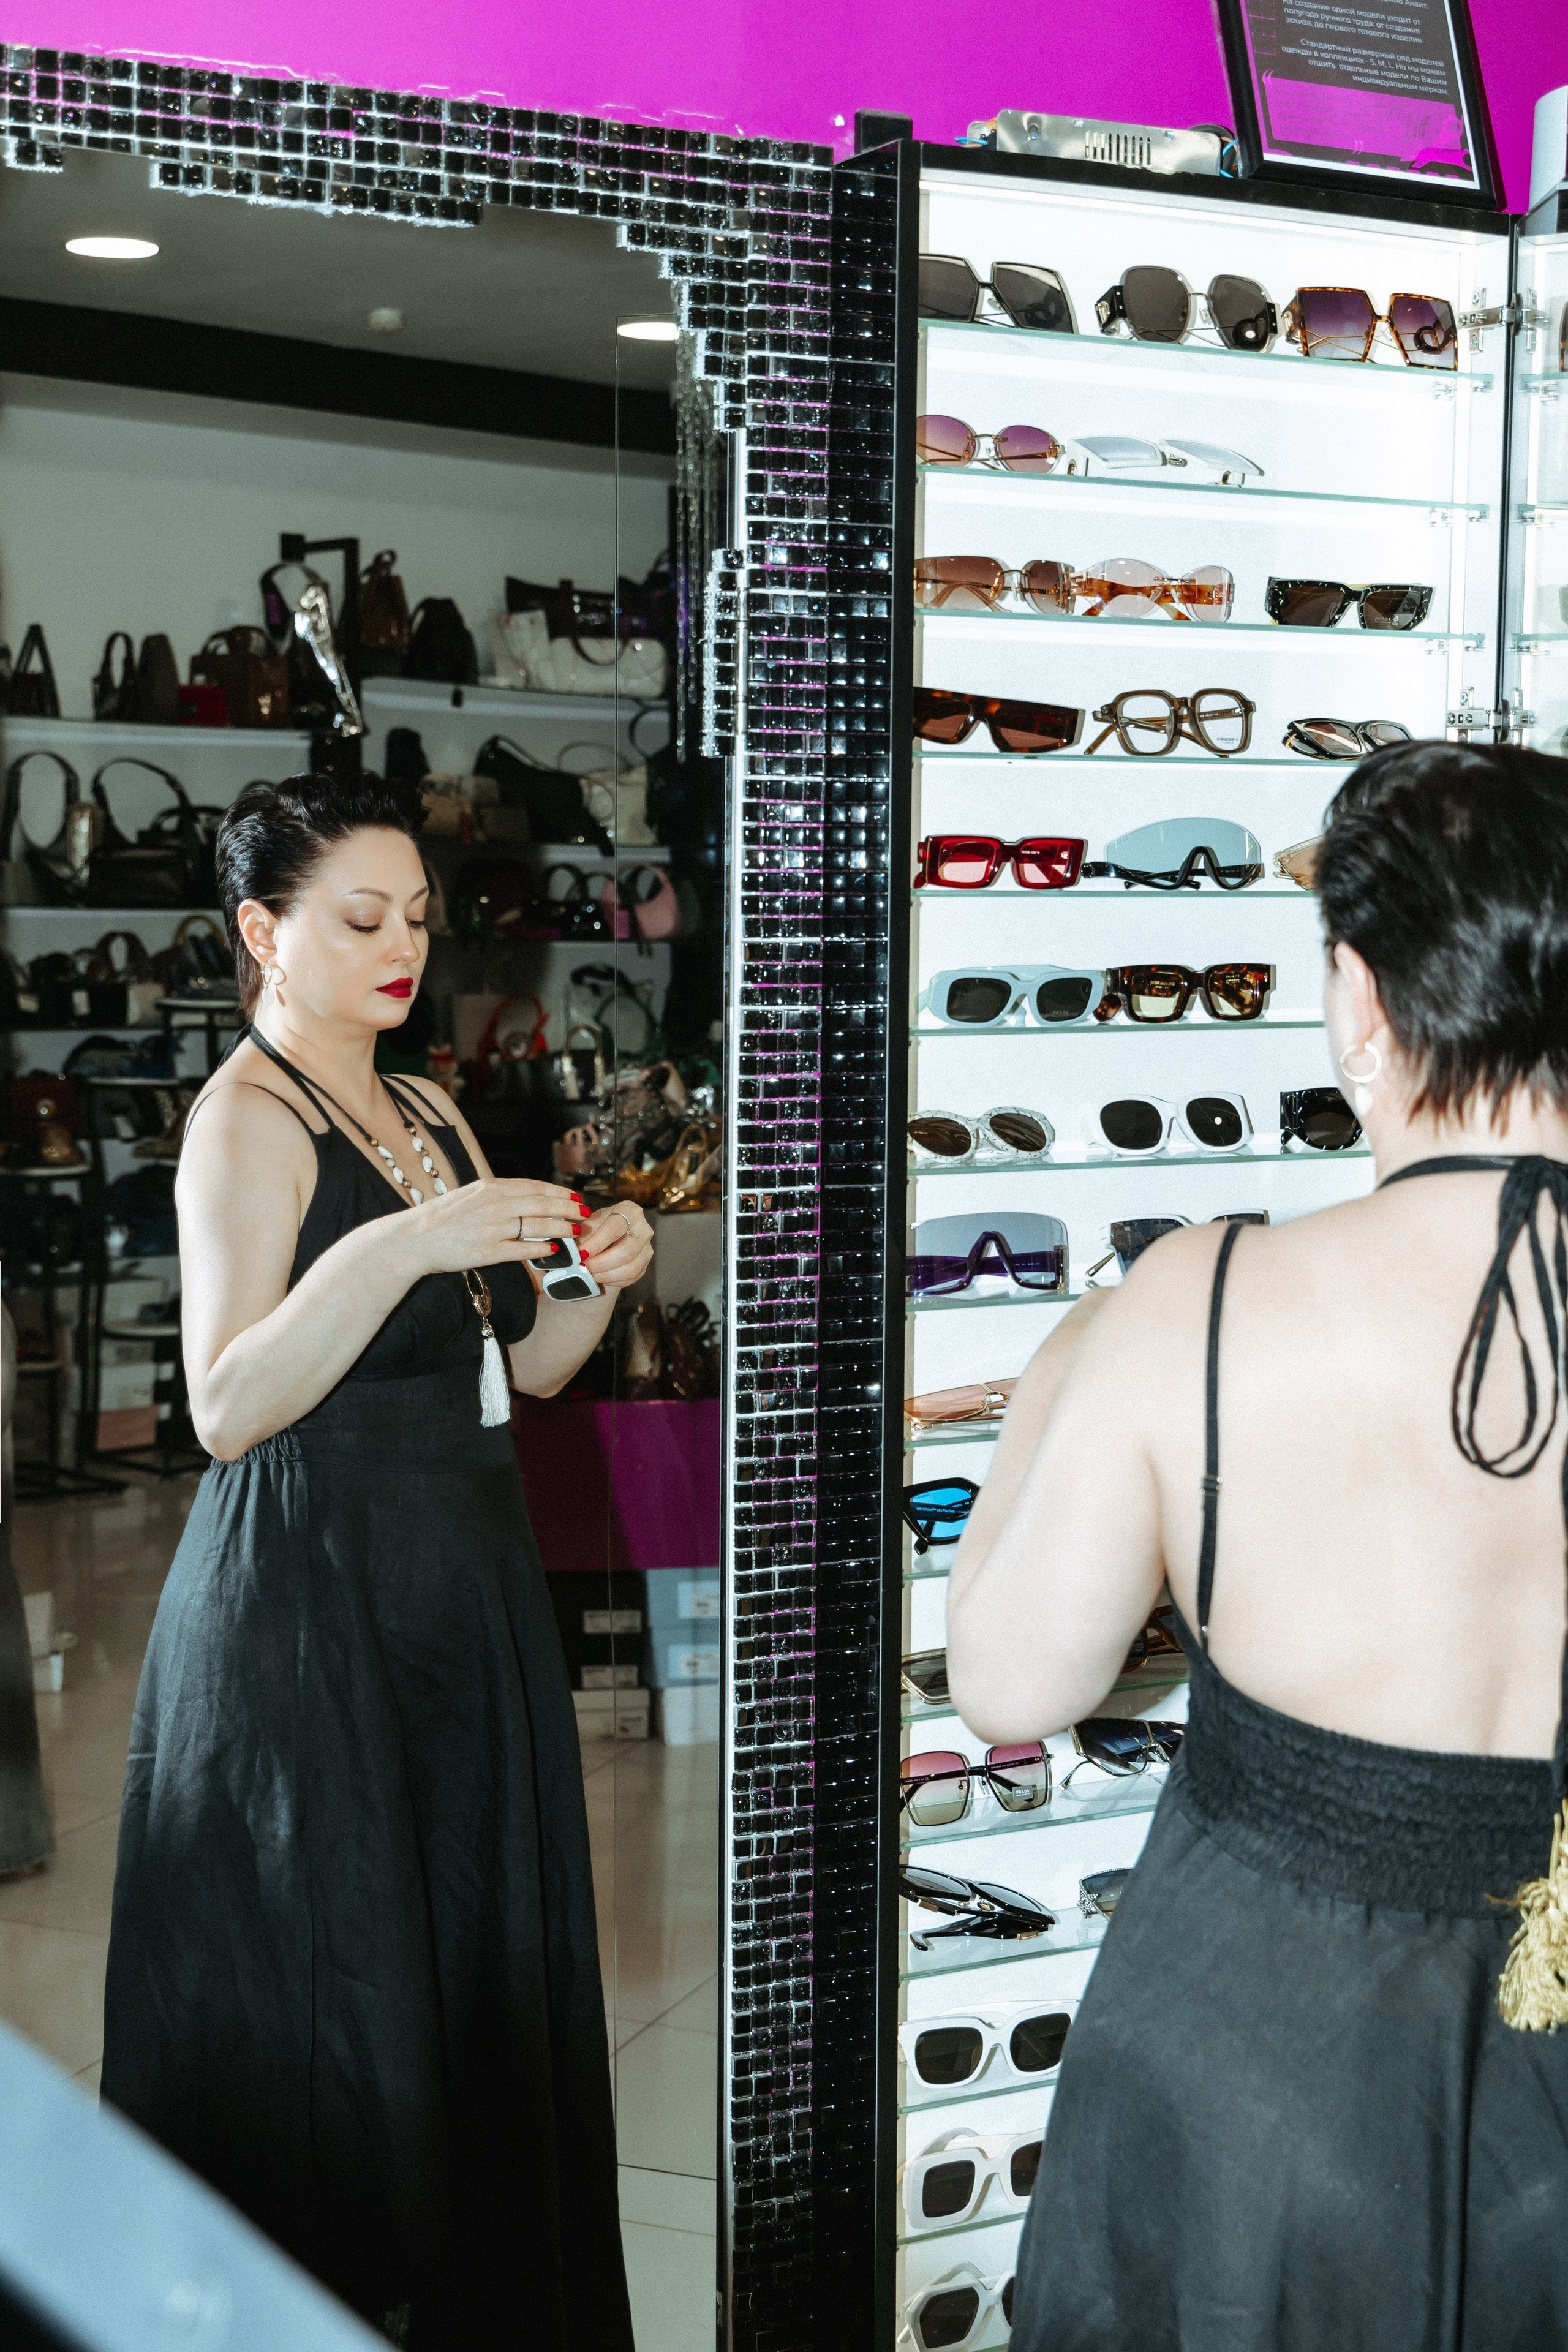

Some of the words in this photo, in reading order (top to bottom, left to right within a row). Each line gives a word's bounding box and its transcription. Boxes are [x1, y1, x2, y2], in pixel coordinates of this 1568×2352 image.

[1284, 7, 1319, 18] полугода
[1321, 13, 1351, 24] ручного
[1385, 24, 1421, 34] создания
[1294, 1, 1330, 11] создание
[1332, 7, 1355, 15] одной
[1357, 10, 1385, 19] модели
[1387, 15, 1411, 24] уходит
[1285, 17, 1313, 27] эскиза,
[1325, 23, 1356, 34] первого
[1357, 29, 1390, 39] готового
[1391, 34, 1424, 44] изделия.
[1281, 46, 1312, 56] одежды
[1320, 52, 1364, 64] коллекциях
[1370, 58, 1377, 67] S,
[1420, 67, 1446, 77] можем
[1300, 39, 1351, 53] Стандартный
[1352, 48, 1395, 59] размерный
[1412, 57, 1444, 67] моделей
[1308, 59, 1336, 69] отшить
[1339, 64, 1379, 75] отдельные
[1380, 70, 1409, 80] модели
[1421, 75, 1447, 85] Вашим
[1352, 75, 1418, 90] индивидуальным
[1419, 86, 1449, 95] меркам.
